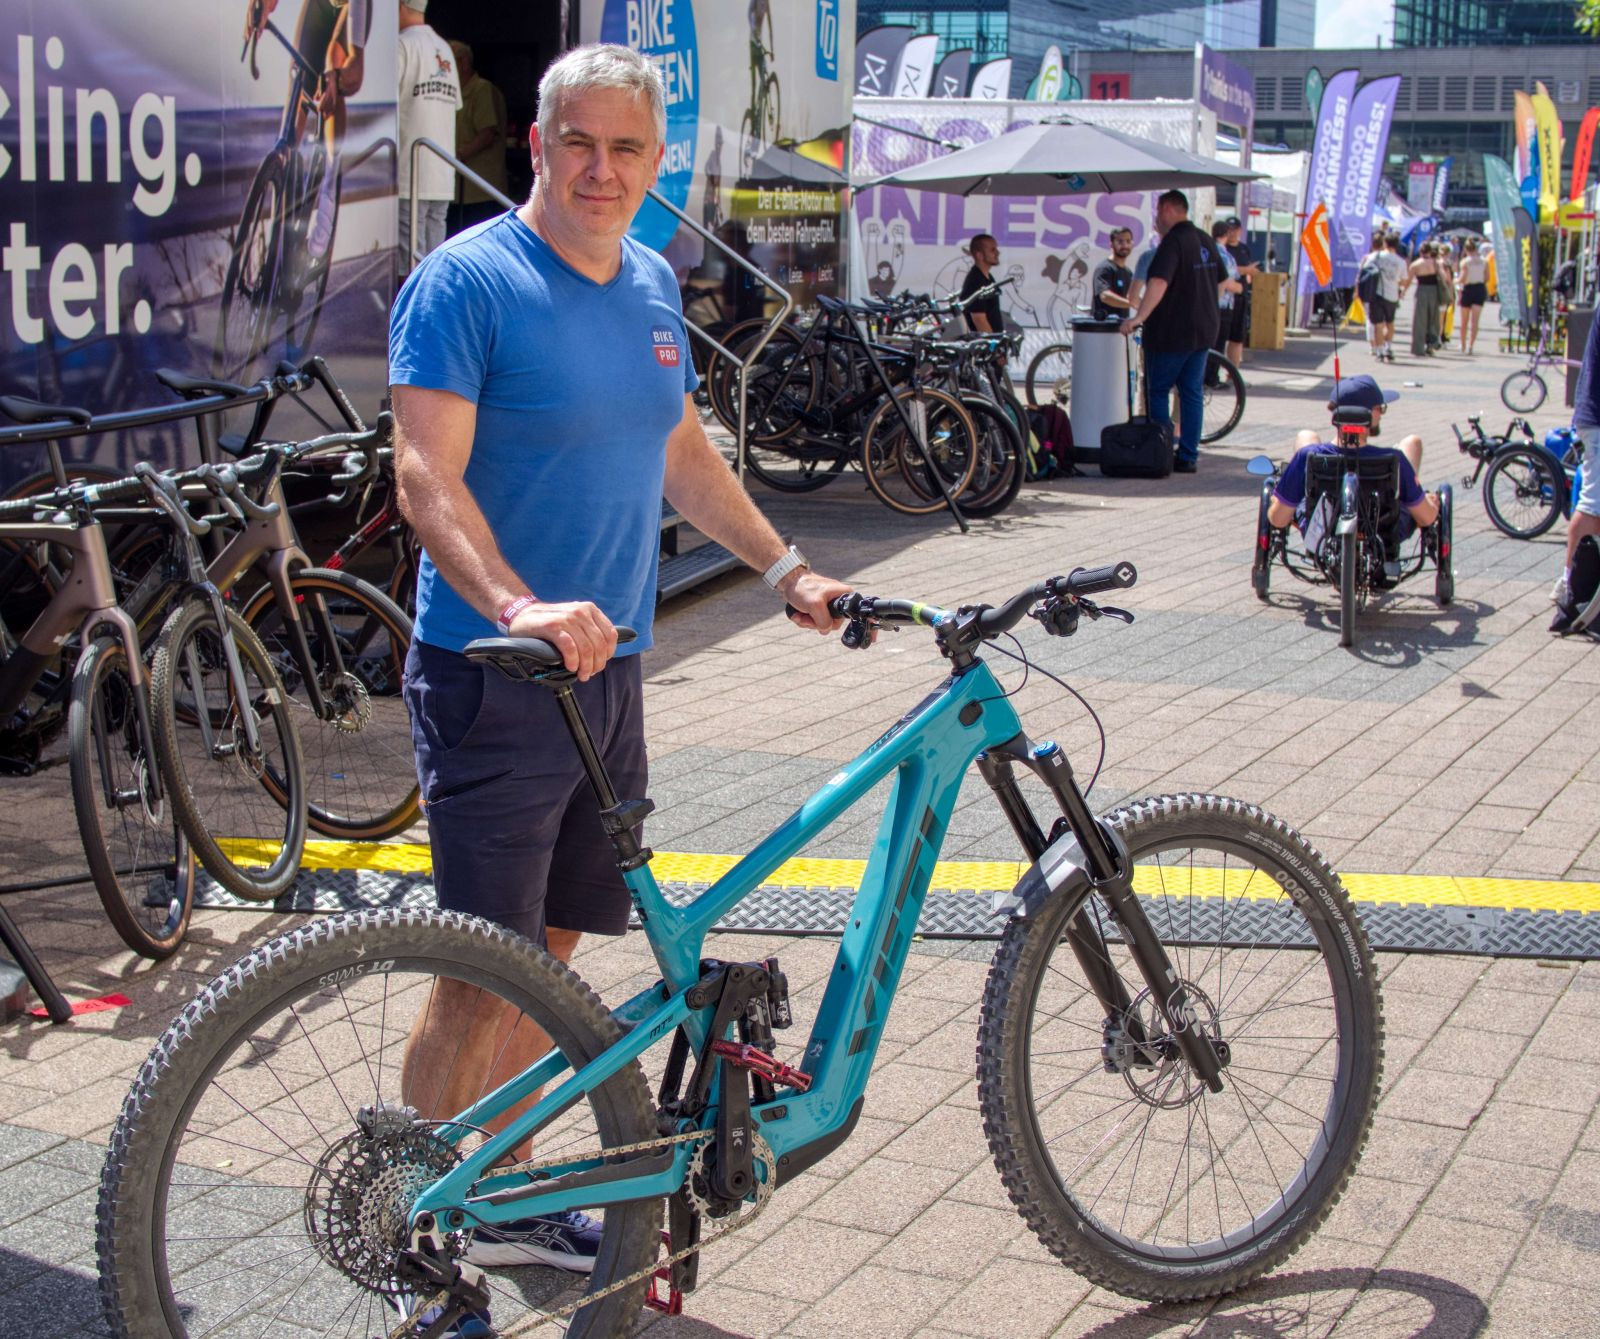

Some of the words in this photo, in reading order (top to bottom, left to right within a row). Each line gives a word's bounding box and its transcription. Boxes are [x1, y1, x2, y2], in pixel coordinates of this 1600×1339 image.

[626, 0, 676, 50] BIKE
[1097, 81, 1120, 99] 11
[1354, 101, 1387, 218] CHAINLESS!
[758, 186, 772, 210] Der
[823, 188, 836, 212] mit
[746, 217, 766, 244] dem
[767, 217, 795, 244] besten
[3, 222, 152, 344] ter.
[652, 331, 674, 343] BIKE
[659, 349, 677, 361] PRO
[1280, 847, 1303, 872] TRAIL
[1275, 870, 1310, 905] 1900
[1301, 868, 1324, 889] MARY
[1318, 887, 1345, 921] MAGIC
[1338, 919, 1362, 972] SCHWALBE
[319, 964, 365, 988] SWISS
[367, 959, 396, 974] DT
